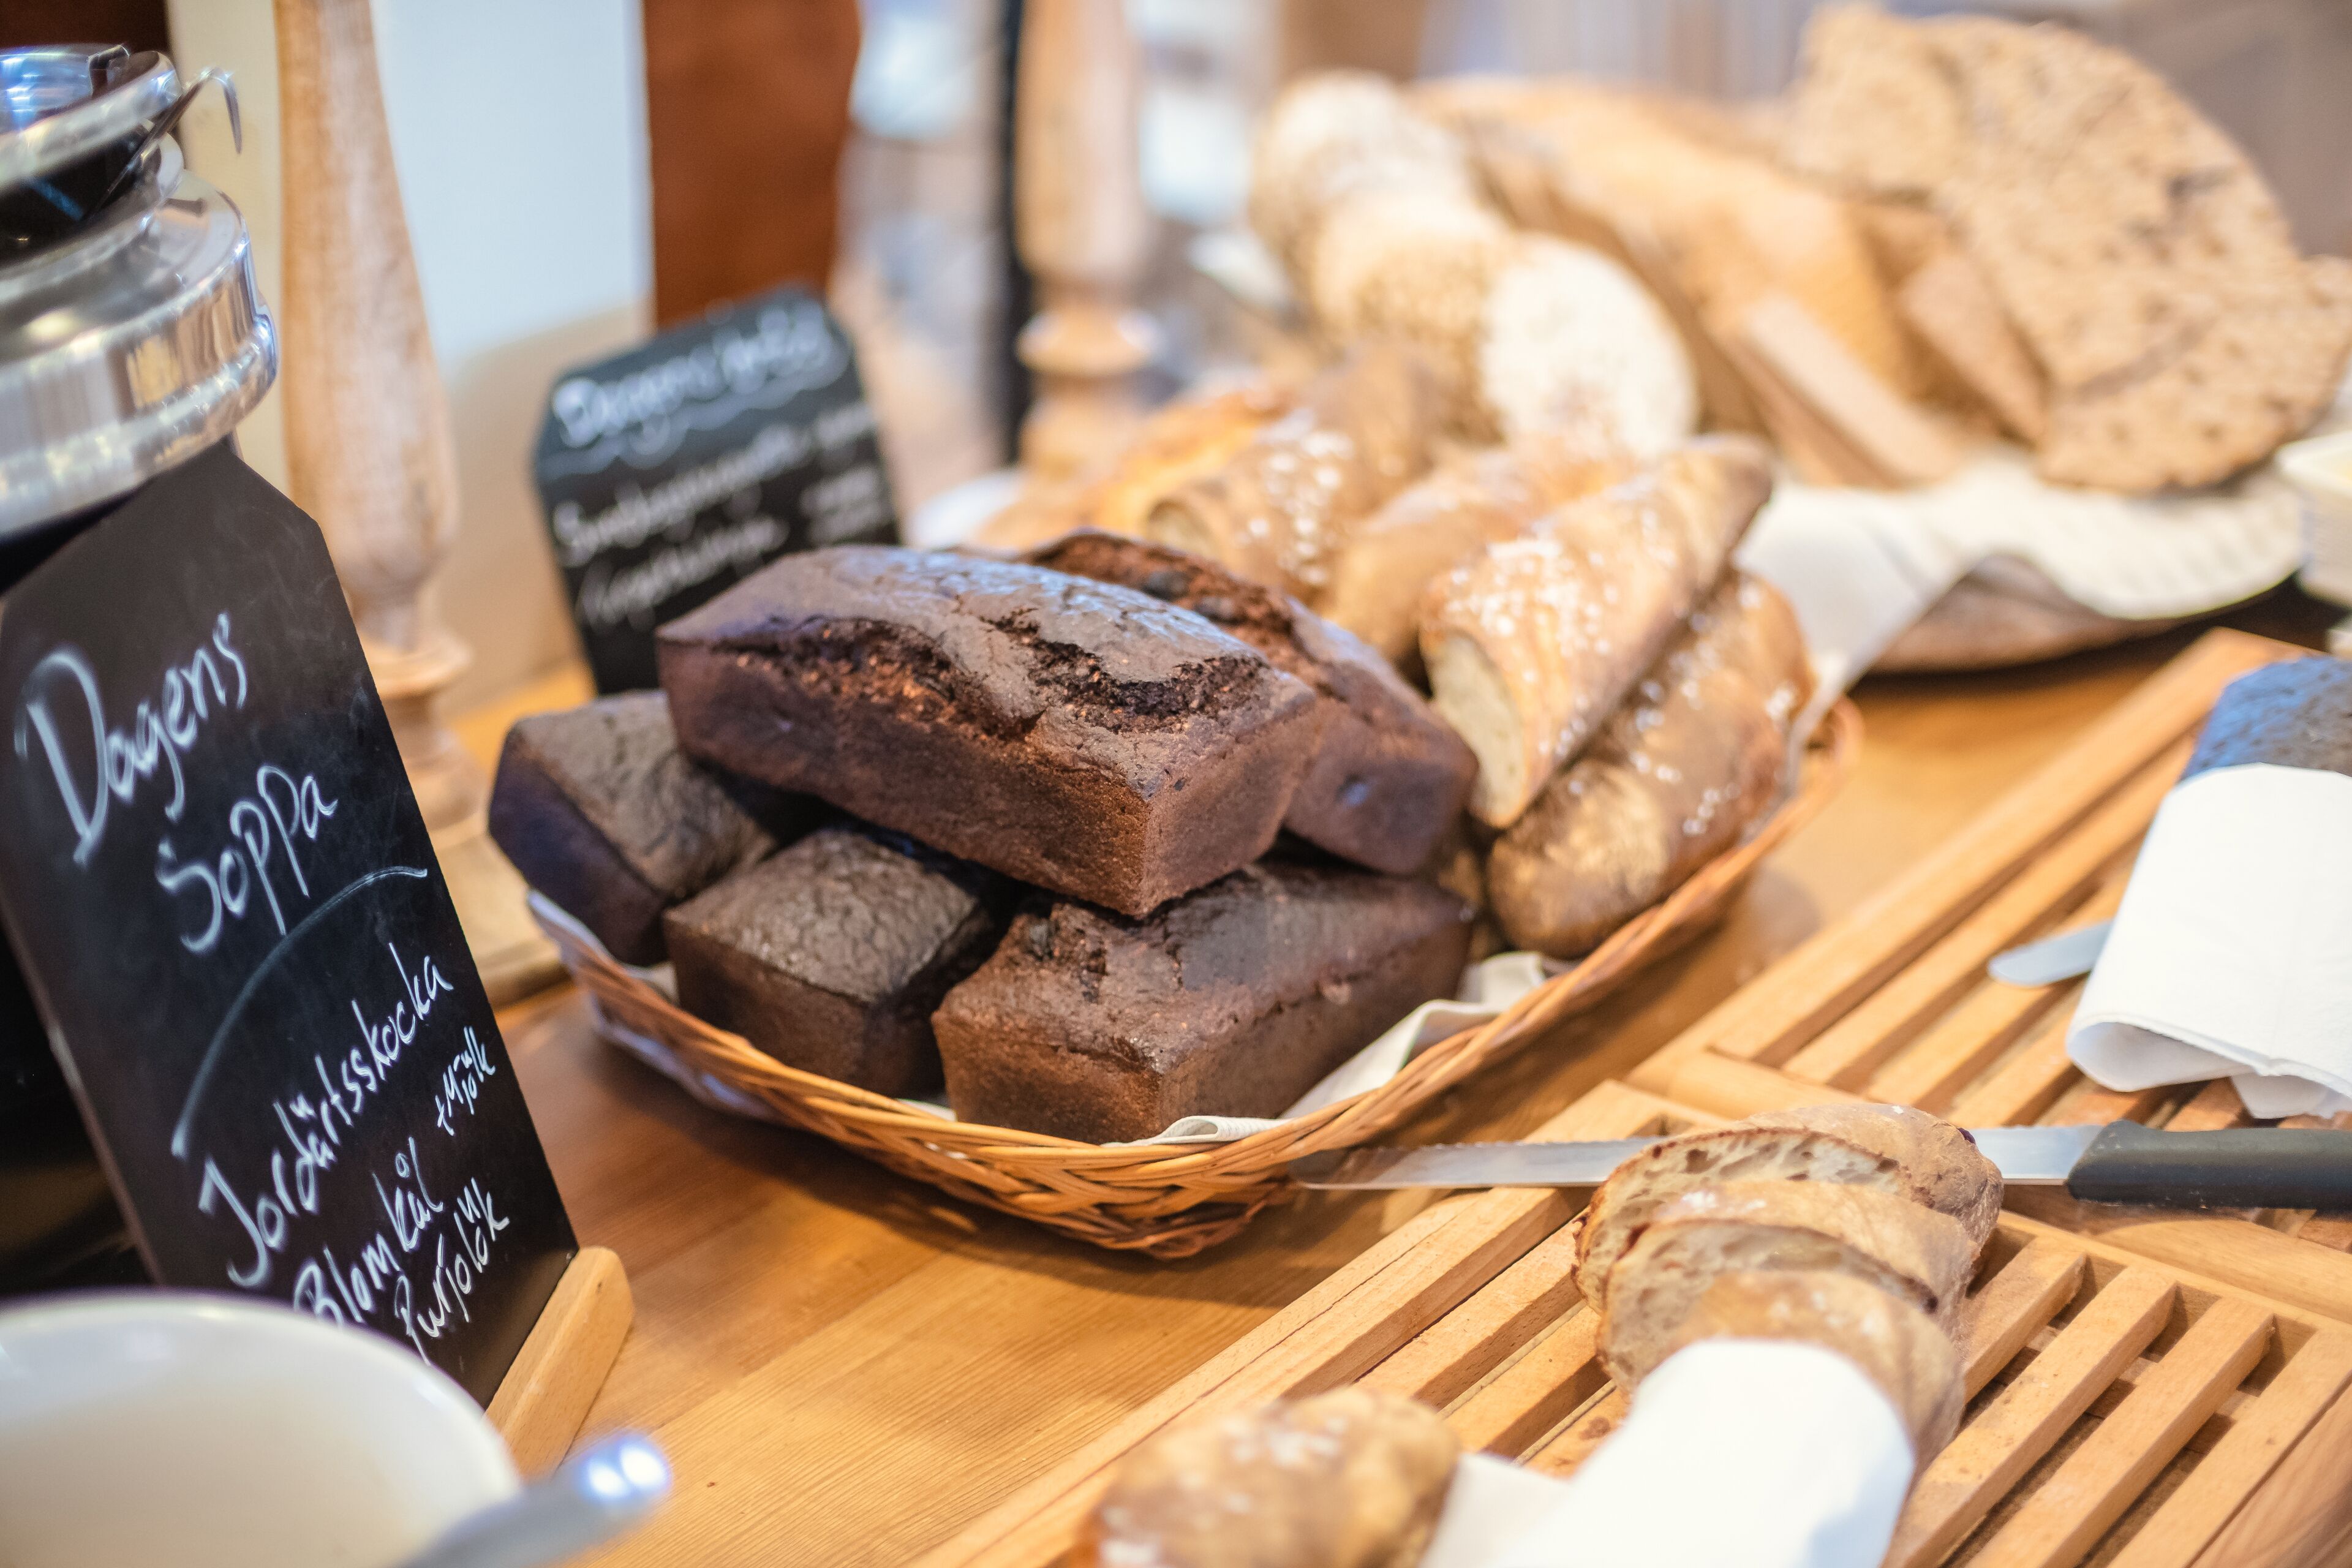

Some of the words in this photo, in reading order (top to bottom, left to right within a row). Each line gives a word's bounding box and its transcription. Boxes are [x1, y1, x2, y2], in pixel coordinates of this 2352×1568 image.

[14, 611, 247, 864] Dagens
[153, 764, 339, 954] Soppa
[197, 941, 454, 1287] Jordärtsskocka
